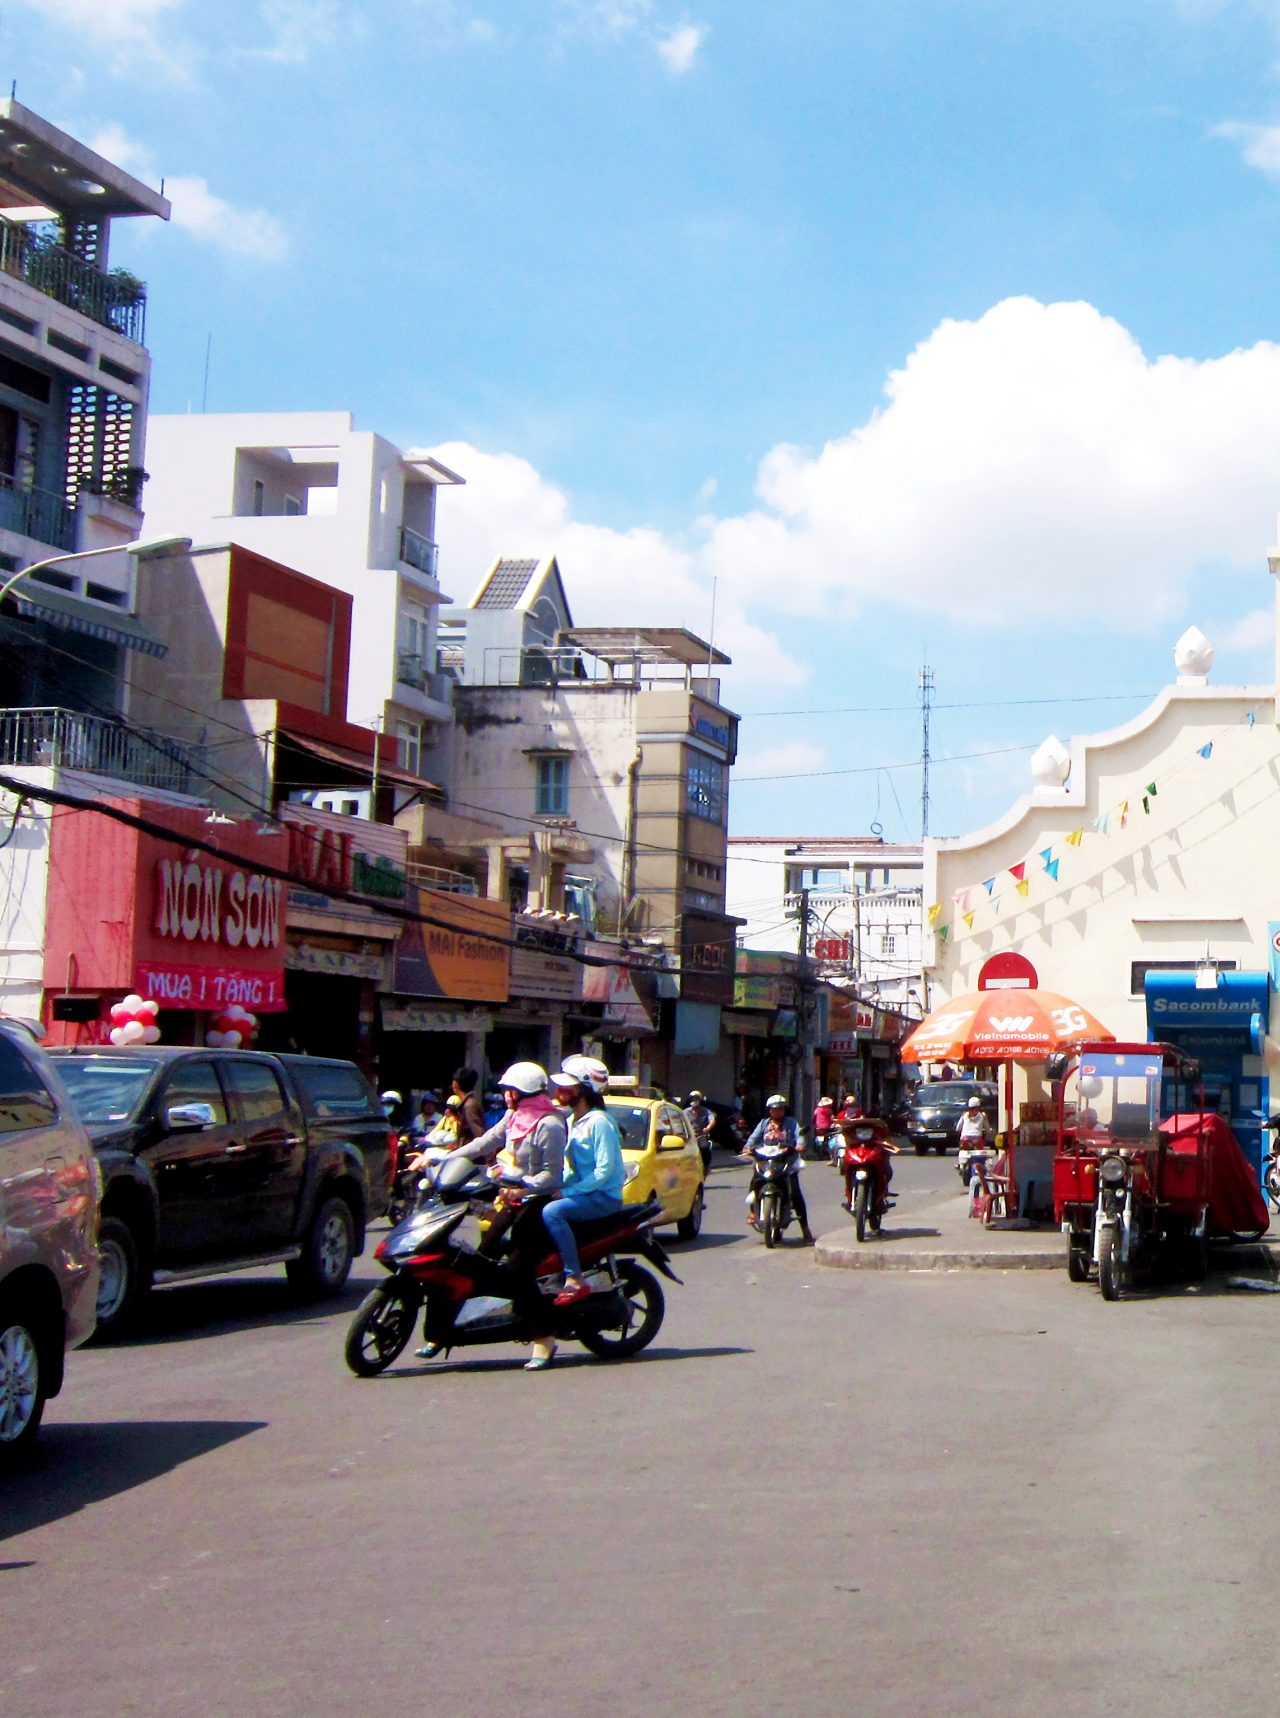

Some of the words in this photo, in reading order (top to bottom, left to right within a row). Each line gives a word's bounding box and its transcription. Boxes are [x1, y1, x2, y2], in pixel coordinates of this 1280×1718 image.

[160, 849, 223, 943] NÓN
[226, 871, 281, 949] SƠN
[147, 972, 192, 999] MUA
[1153, 998, 1261, 1012] Sacombank
[1051, 1005, 1088, 1036] 3G
[974, 1032, 1050, 1040] Vietnamobile
